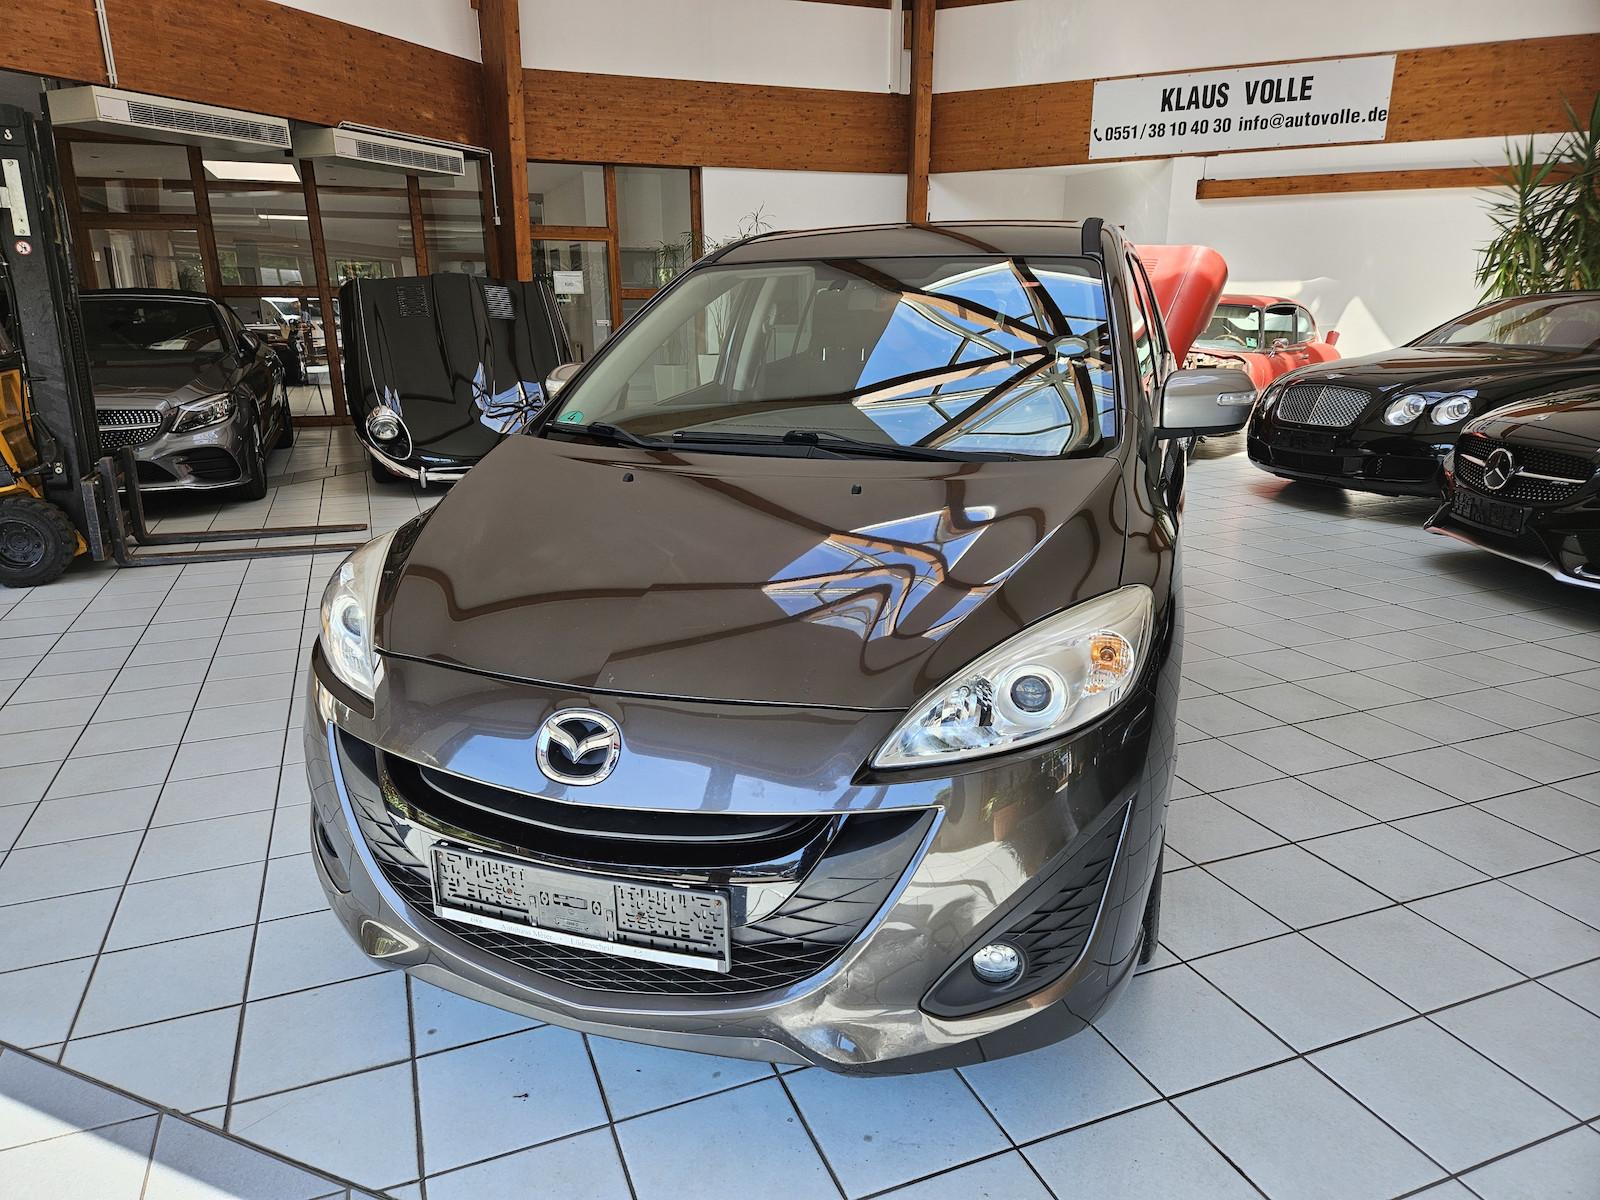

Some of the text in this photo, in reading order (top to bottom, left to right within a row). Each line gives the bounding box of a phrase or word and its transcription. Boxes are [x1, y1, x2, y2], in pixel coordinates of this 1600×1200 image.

[1160, 75, 1315, 113] KLAUS VOLLE
[1105, 106, 1388, 142] 0551/38 10 40 30 info@autovolle.de
